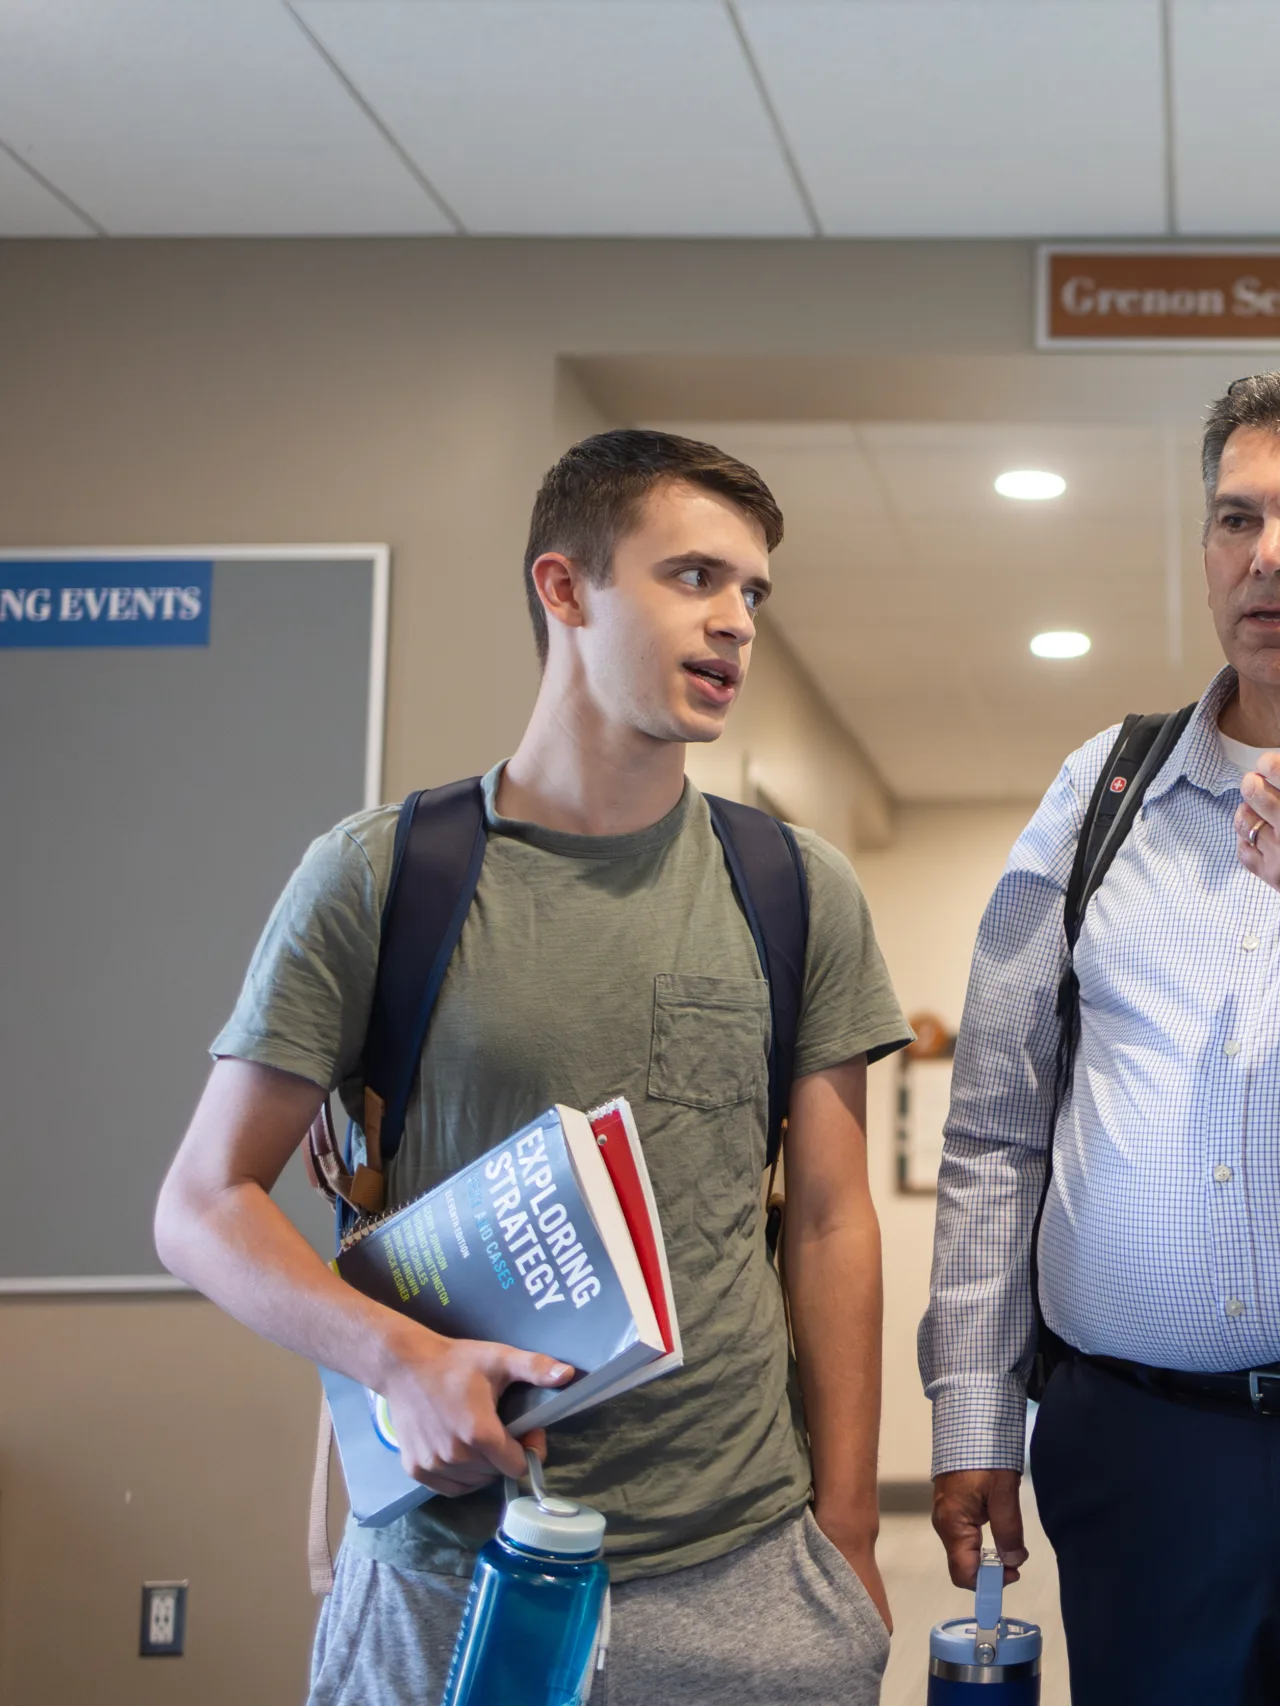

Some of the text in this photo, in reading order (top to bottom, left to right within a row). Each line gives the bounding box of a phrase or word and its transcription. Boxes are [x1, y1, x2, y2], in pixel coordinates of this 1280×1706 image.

[1061, 275, 1224, 317] Grenon
[0, 586, 201, 622] NG EVENTS
[445, 1189, 471, 1259] ELEVENTH EDITION
[484, 1151, 566, 1310] STRATEGY
[516, 1127, 602, 1309] EXPLORING
[382, 1232, 398, 1270] PATRICK
[410, 1246, 429, 1286] SCHOLES
[430, 1232, 448, 1271] JOHNSON
[474, 1210, 494, 1241] AND
[486, 1241, 515, 1290] CASES
[401, 1261, 420, 1297] ANGWIN
[423, 1247, 450, 1306] WHITTINGTON
